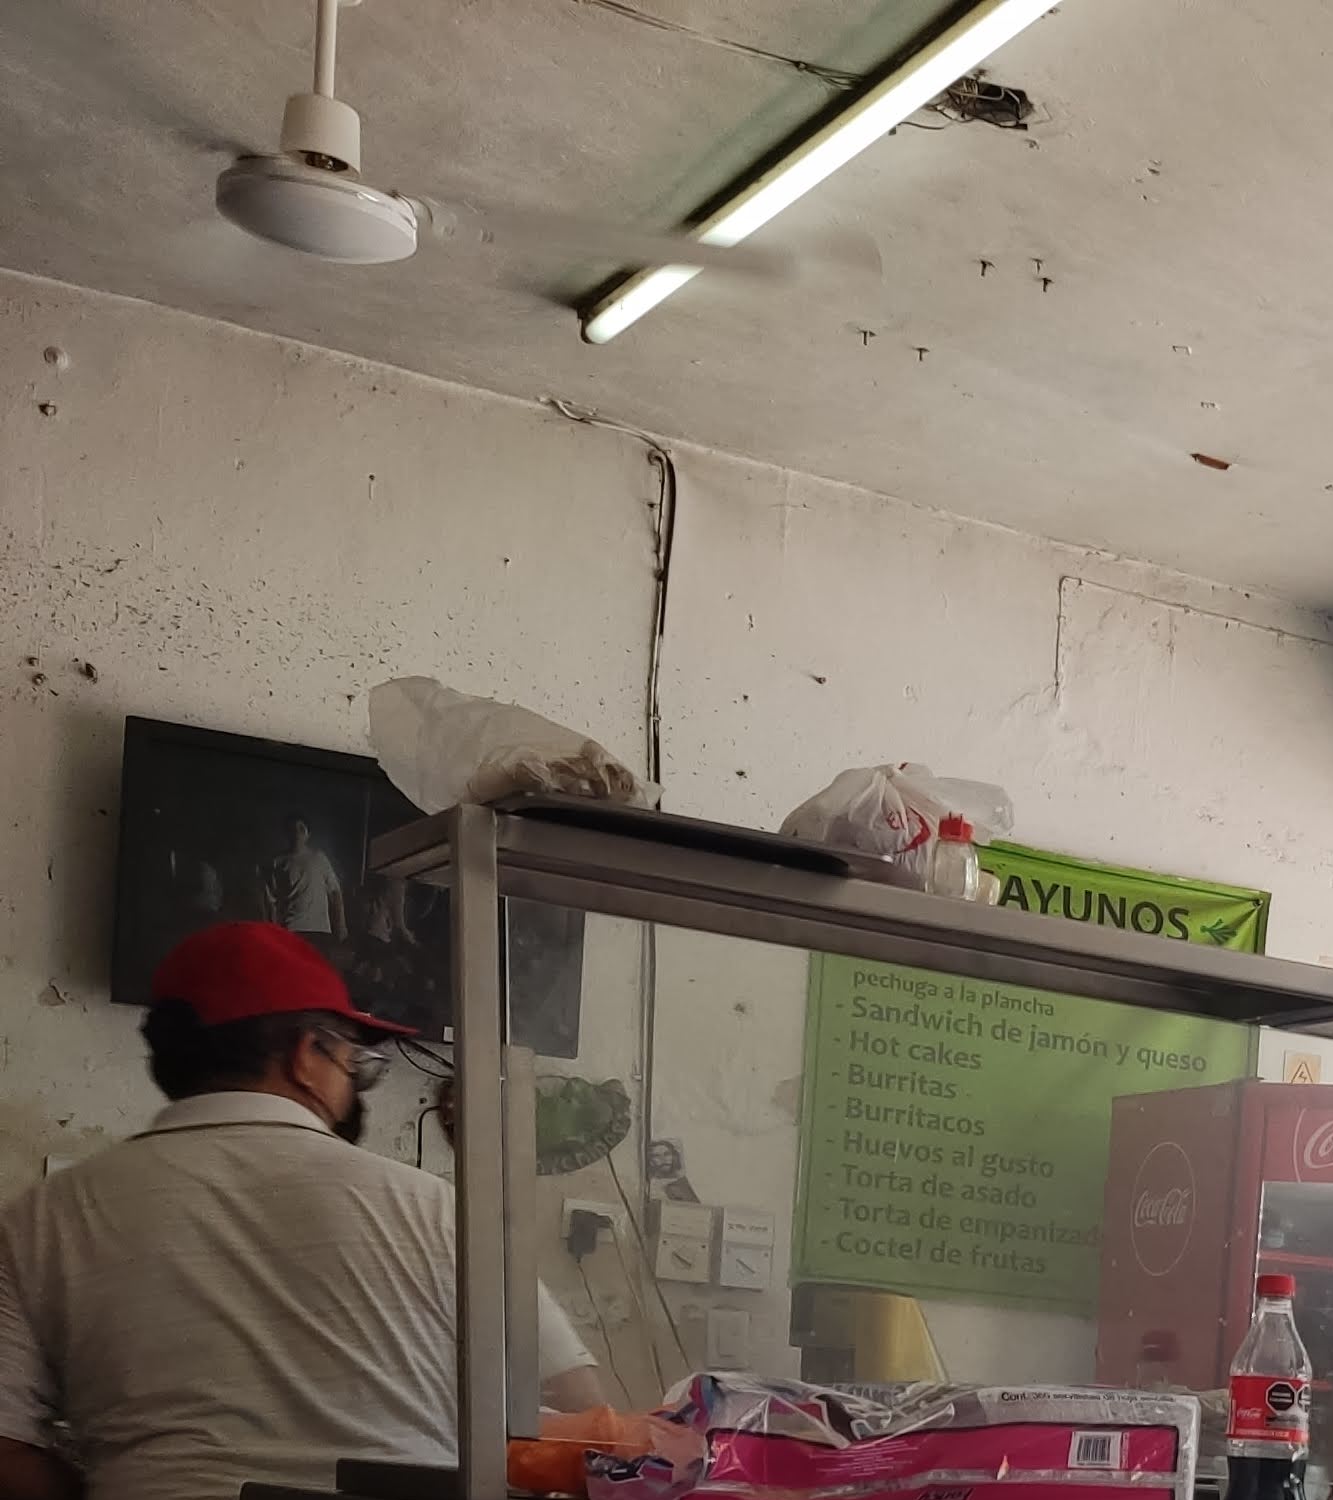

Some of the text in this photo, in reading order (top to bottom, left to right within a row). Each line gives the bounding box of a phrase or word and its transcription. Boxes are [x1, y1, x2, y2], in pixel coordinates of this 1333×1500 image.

[983, 868, 1190, 941] AYUNOS
[853, 970, 1055, 1017] pechuga a la plancha
[849, 1030, 983, 1070] Hot cakes
[852, 996, 1208, 1073] Sandwich de jamón y queso
[848, 1063, 957, 1099] Burritas
[845, 1096, 985, 1136] Burritacos
[842, 1129, 1054, 1178] Huevos al gusto
[841, 1163, 1037, 1209] Torta de asado
[839, 1197, 1103, 1247] Torta de empanizad
[835, 1231, 1047, 1273] Coctel de frutas
